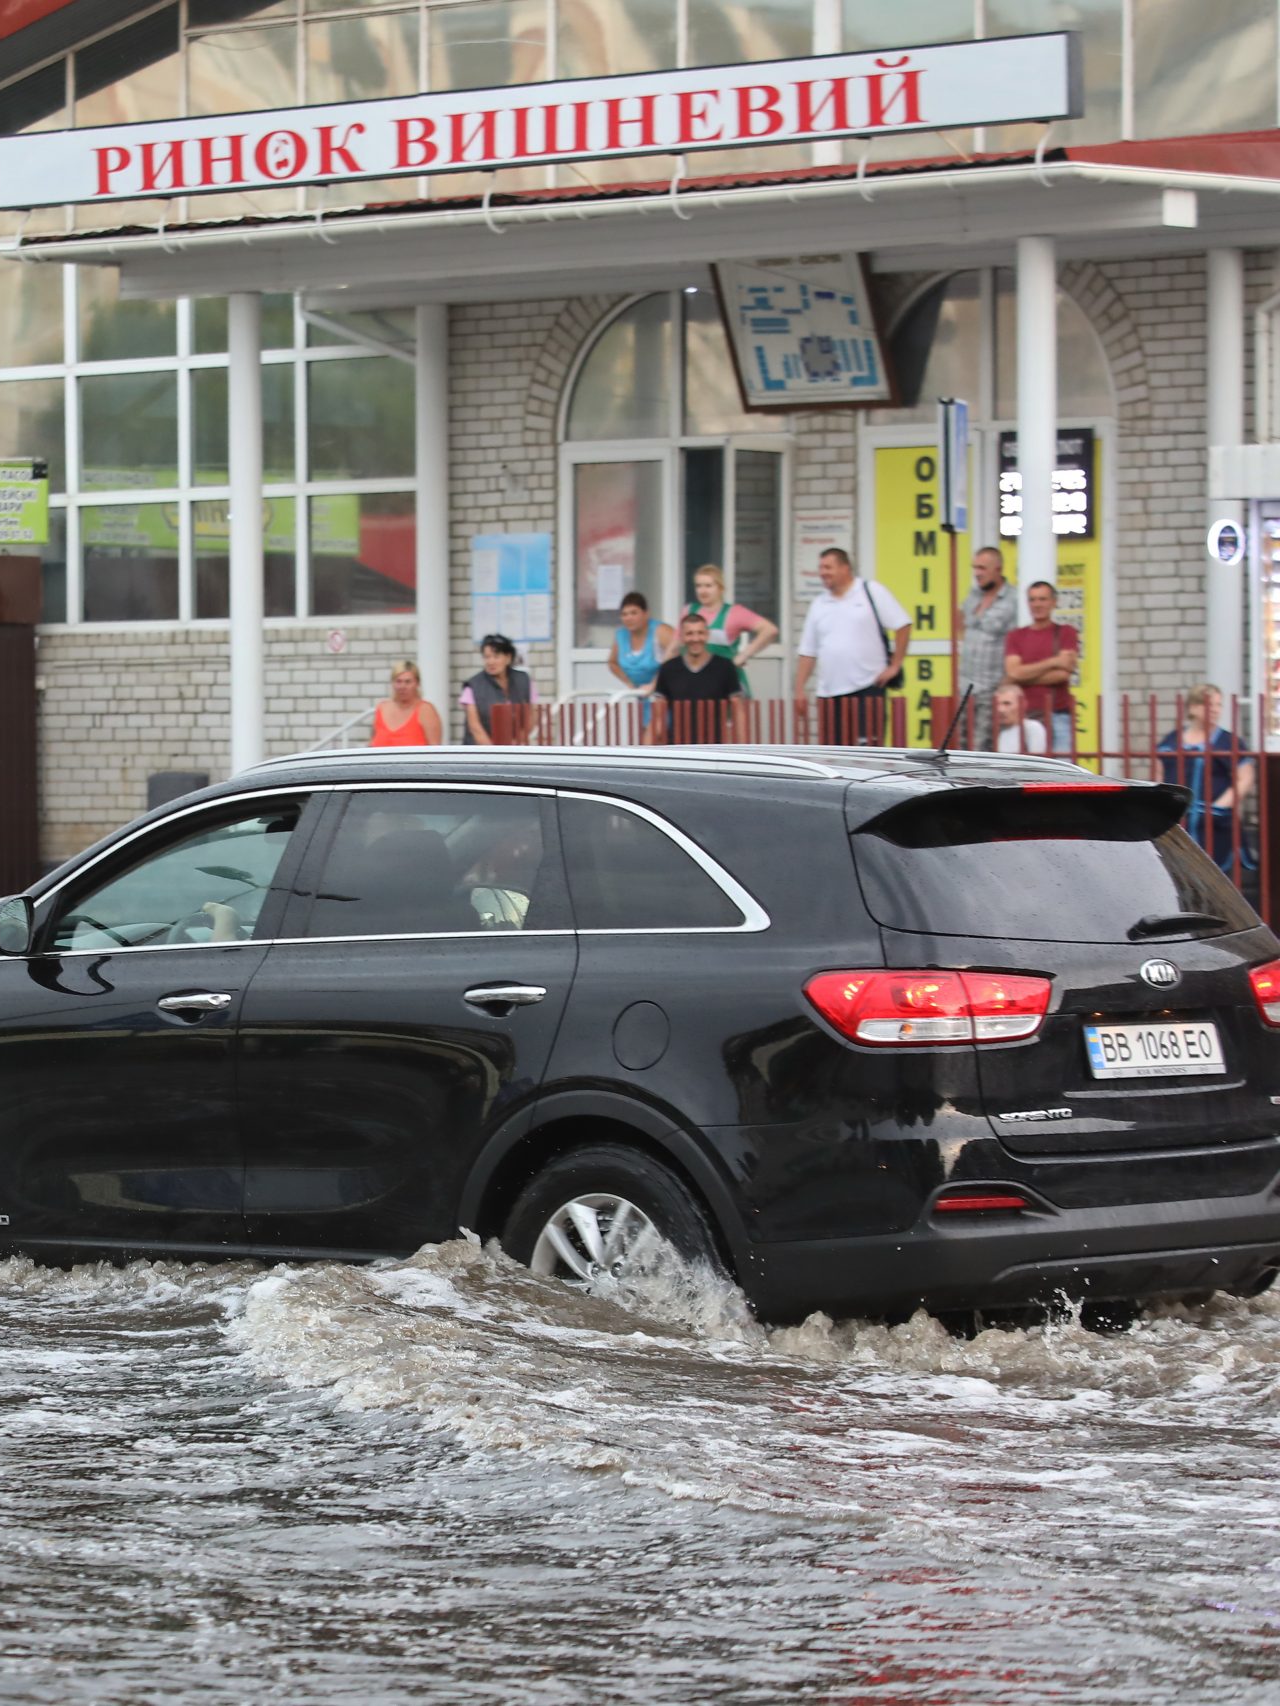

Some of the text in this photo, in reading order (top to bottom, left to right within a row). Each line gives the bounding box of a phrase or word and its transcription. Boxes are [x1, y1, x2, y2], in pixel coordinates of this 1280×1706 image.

[90, 55, 929, 196] РИНОК ВИШНЕВИЙ
[913, 456, 937, 631] ОБМІН
[1146, 964, 1179, 983] KIA
[1100, 1032, 1132, 1063] BB
[1135, 1030, 1181, 1060] 1068
[998, 1107, 1073, 1122] SORENTO
